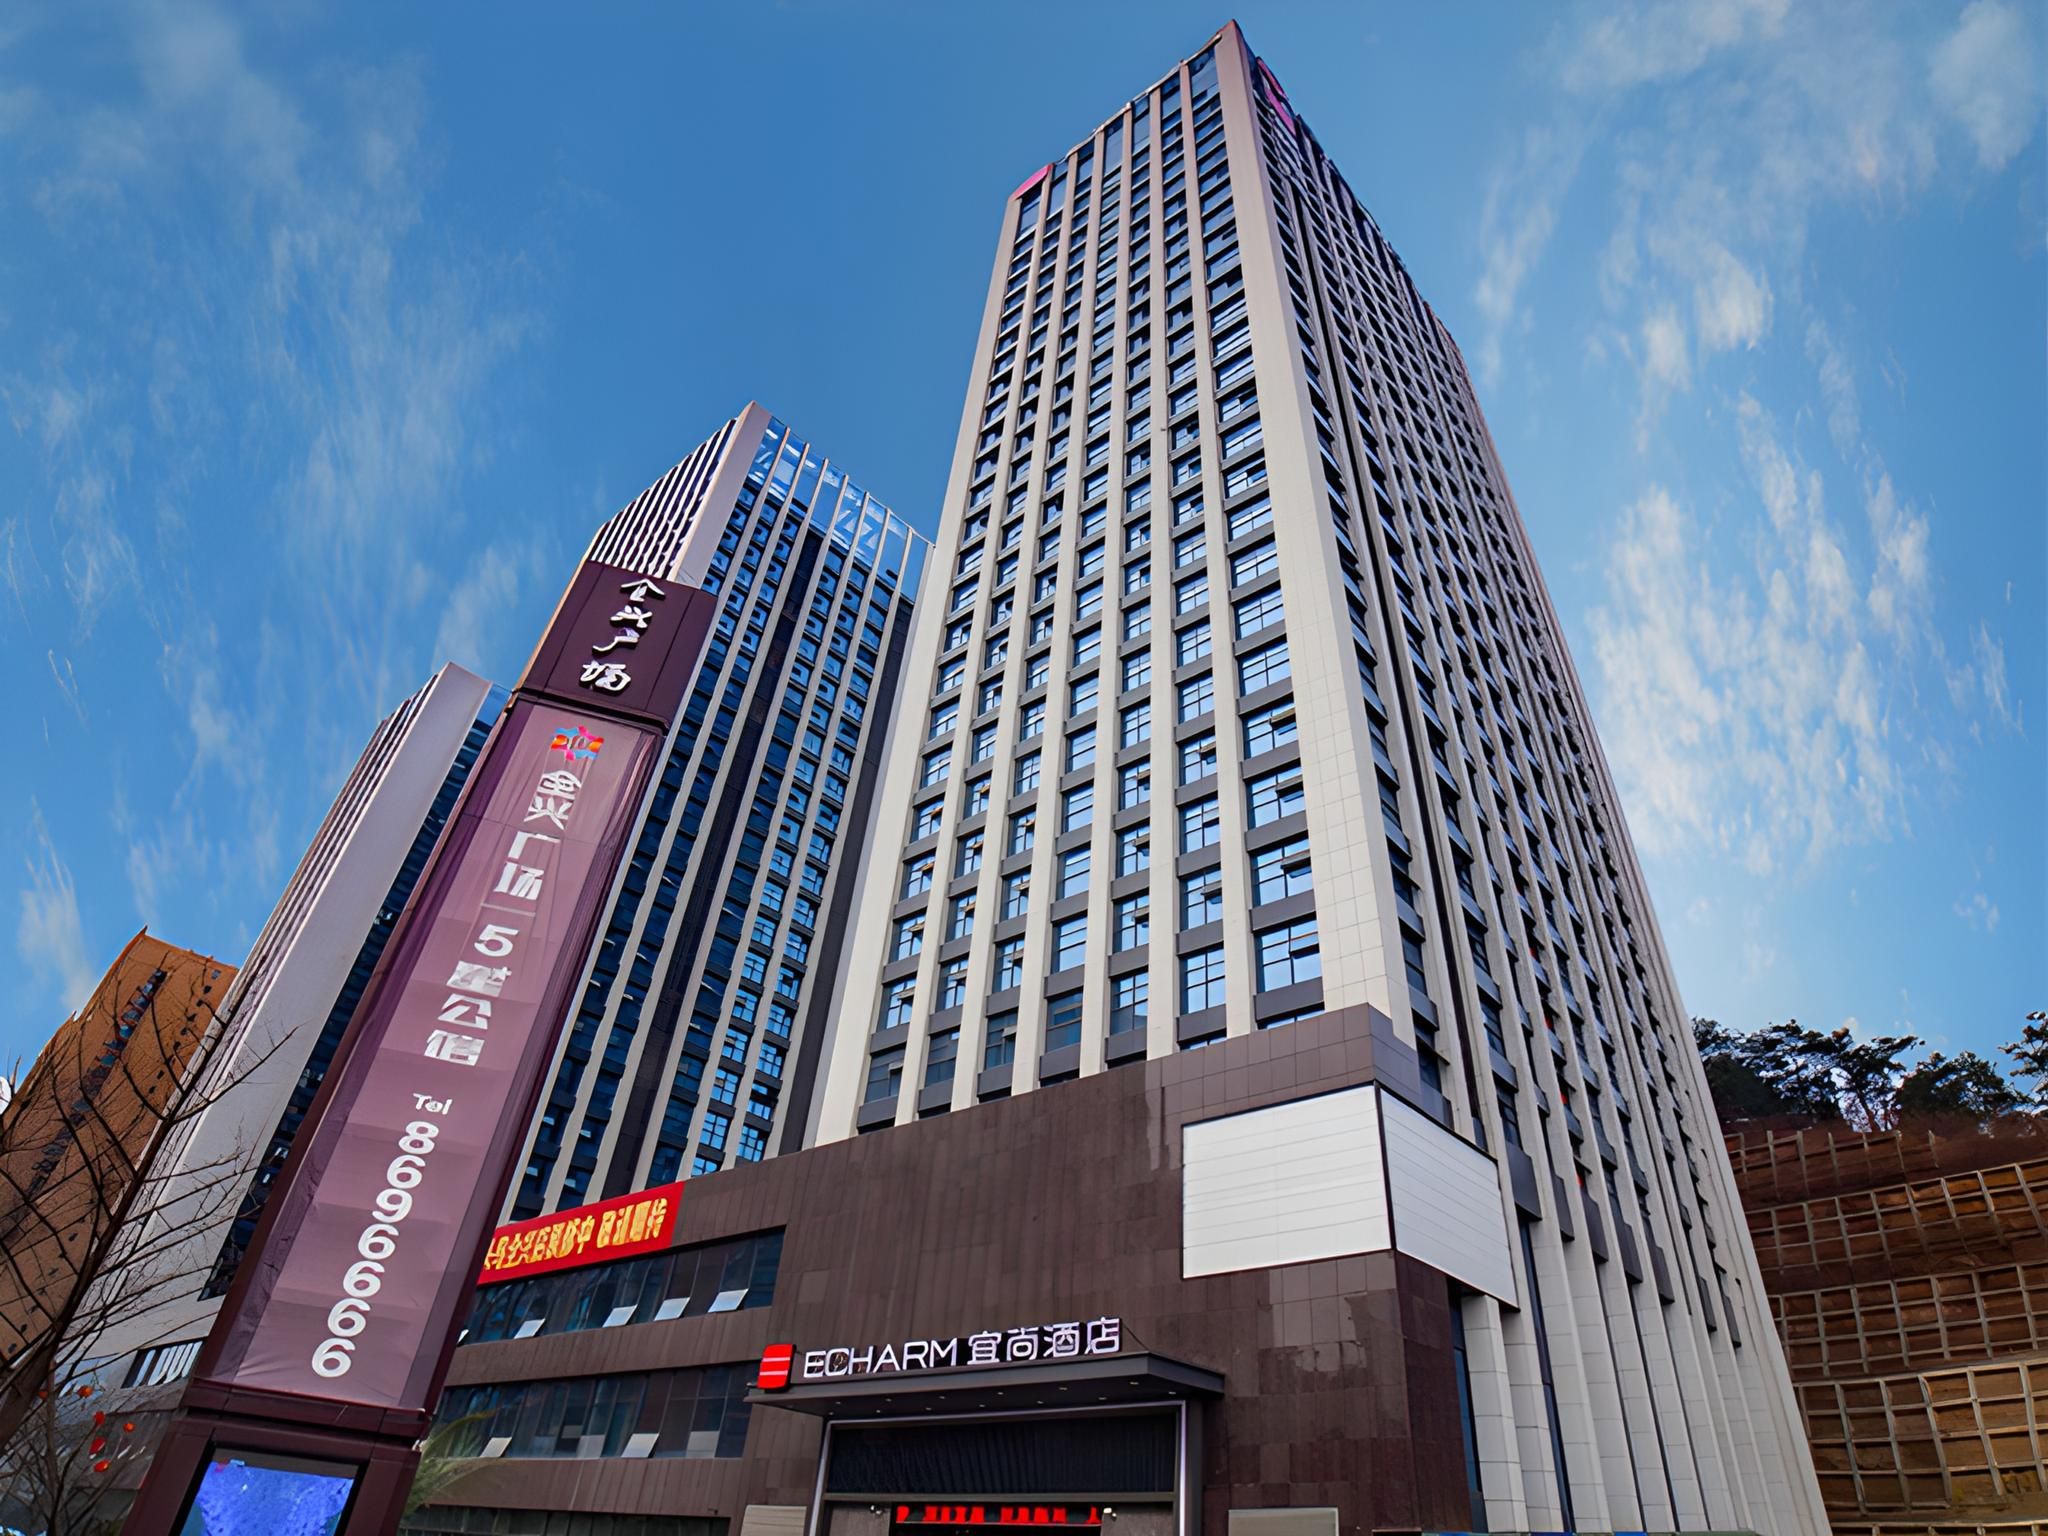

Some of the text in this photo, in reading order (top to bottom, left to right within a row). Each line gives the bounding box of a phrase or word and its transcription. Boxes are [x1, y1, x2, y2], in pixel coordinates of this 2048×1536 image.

[311, 1120, 440, 1379] 8696666
[803, 1316, 1121, 1379] ECHARM 宜尚酒店
